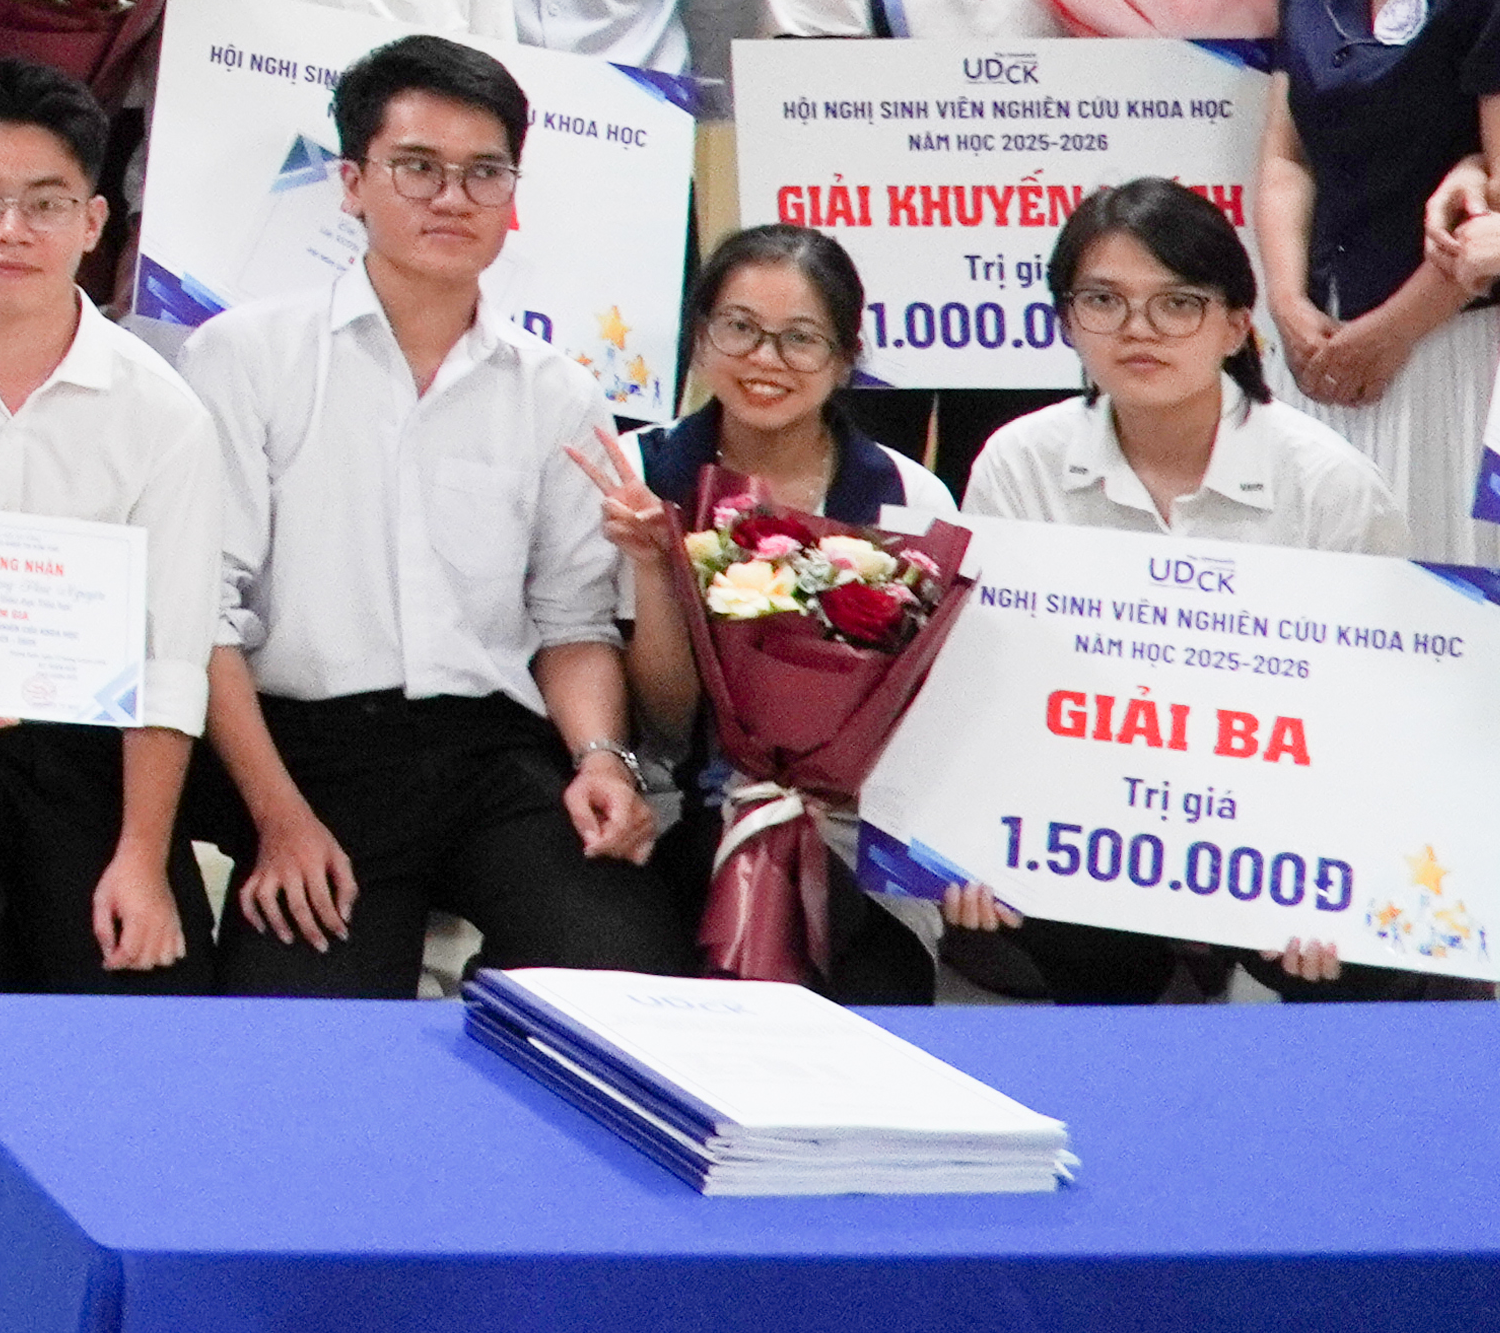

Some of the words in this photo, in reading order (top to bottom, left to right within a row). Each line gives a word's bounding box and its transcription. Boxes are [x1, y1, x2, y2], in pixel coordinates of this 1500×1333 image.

[210, 44, 243, 71] HỘI
[250, 54, 297, 84] NGHỊ
[963, 58, 1040, 85] UDCK
[544, 112, 598, 137] KHOA
[607, 124, 646, 147] HỌC
[783, 96, 817, 125] HỘI
[824, 101, 873, 125] NGHỊ
[880, 101, 929, 119] SINH
[935, 96, 985, 119] VIÊN
[992, 96, 1071, 119] NGHIÊN
[1077, 96, 1120, 119] CỨU
[1126, 99, 1185, 119] KHOA
[1189, 95, 1236, 124] HỌC
[908, 131, 950, 151] NĂM
[956, 134, 995, 156] HỌC
[1001, 133, 1109, 152] 2025-2026
[778, 174, 873, 229] GIẢI
[887, 170, 1082, 227] KHUYẾN
[963, 254, 1006, 290] Trị
[1149, 558, 1236, 594] UDCK
[979, 585, 1037, 618] NGHỊ
[1046, 594, 1102, 618] SINH
[1112, 599, 1168, 626] VIÊN
[1177, 608, 1268, 638] NGHIÊN
[1278, 619, 1327, 644] CỨU
[1337, 625, 1404, 652] KHOA
[1413, 632, 1464, 660] HỌC
[1075, 633, 1123, 657] NĂM
[1131, 641, 1175, 667] HỌC
[1184, 647, 1309, 679] 2025-2026
[1046, 688, 1190, 751] GIẢI
[1214, 709, 1311, 766] BA
[1122, 776, 1170, 822] Trị
[1182, 786, 1237, 824] giá
[1000, 815, 1354, 913] 1.500.000Đ
